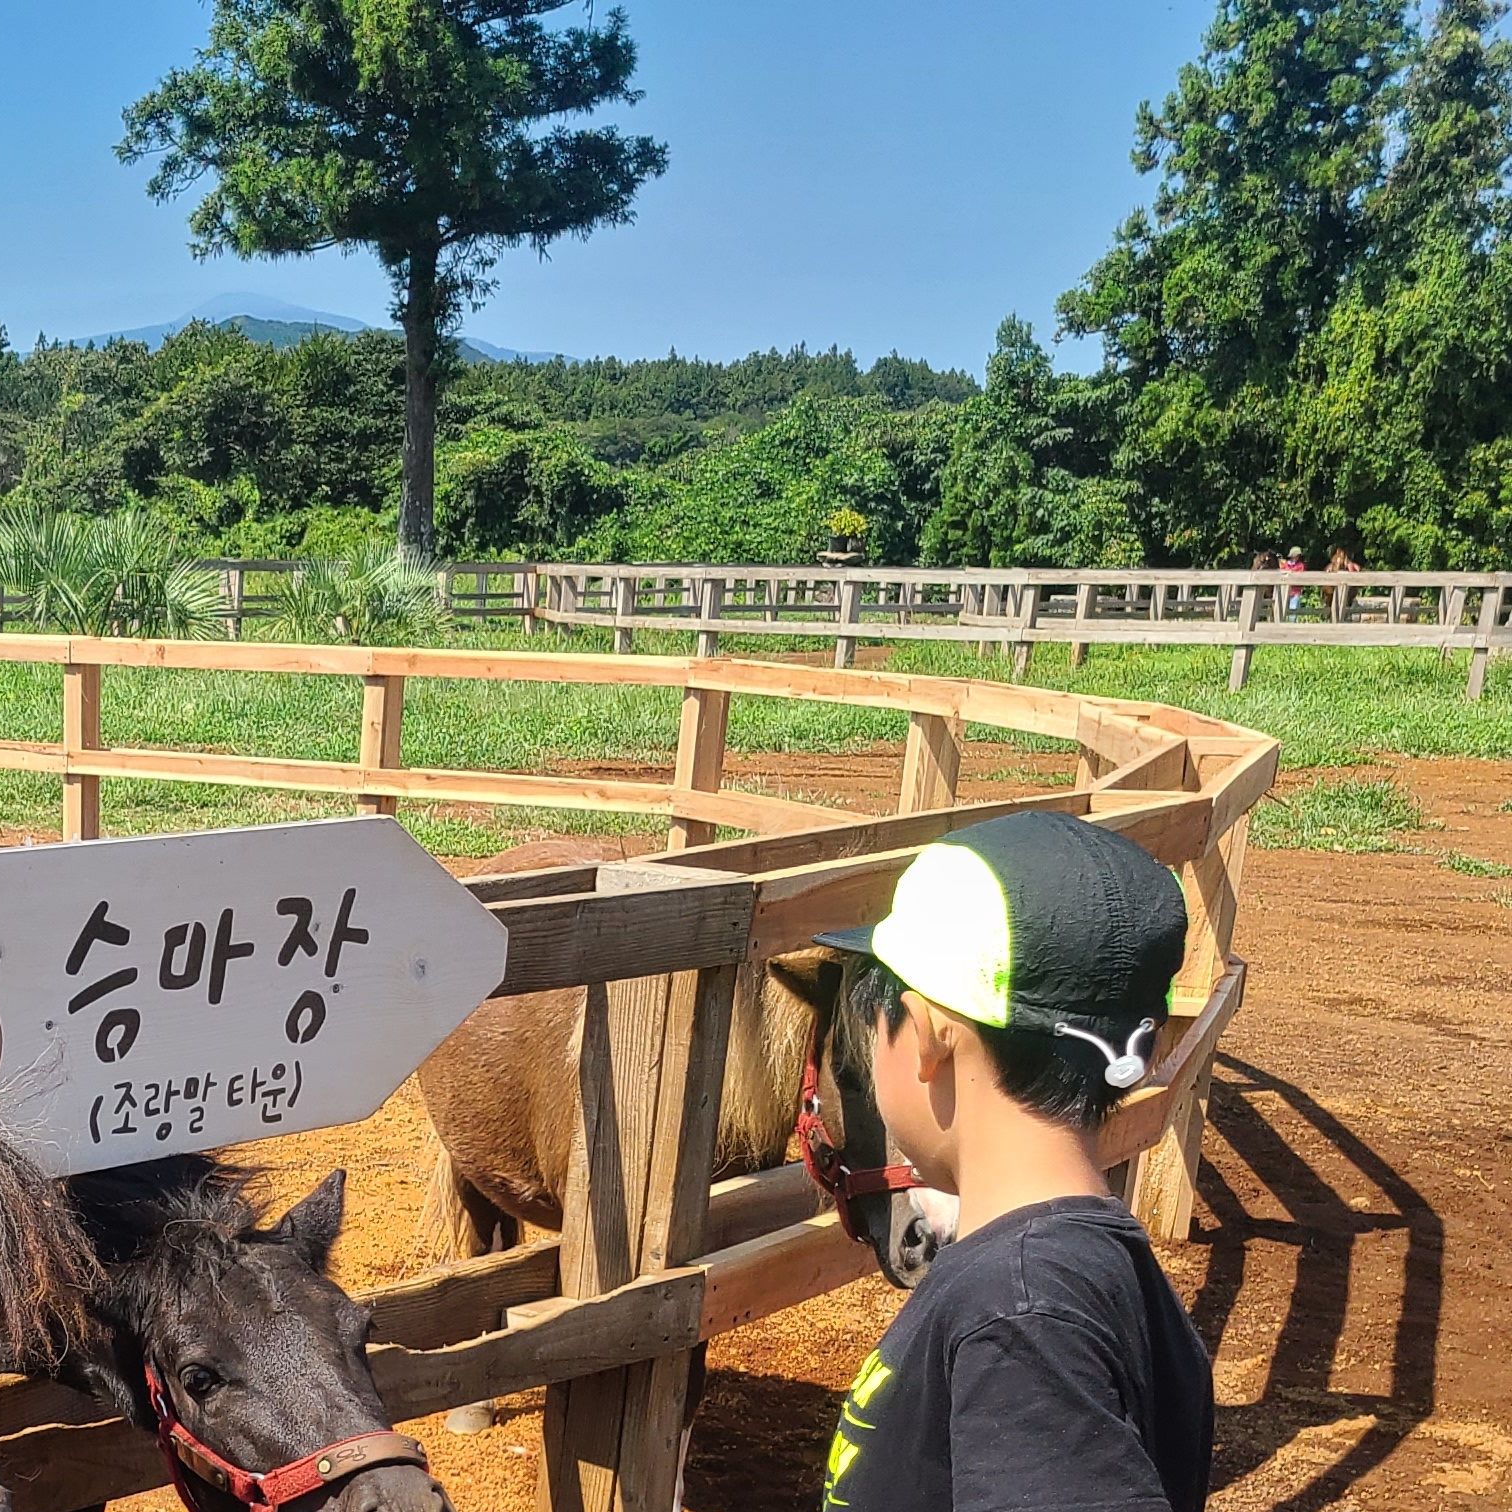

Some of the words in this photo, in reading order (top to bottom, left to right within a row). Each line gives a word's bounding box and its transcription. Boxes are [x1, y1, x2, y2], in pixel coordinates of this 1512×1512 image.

[66, 888, 369, 1062] 승마장
[90, 1073, 217, 1143] (조랑말
[228, 1061, 302, 1123] 타운)
